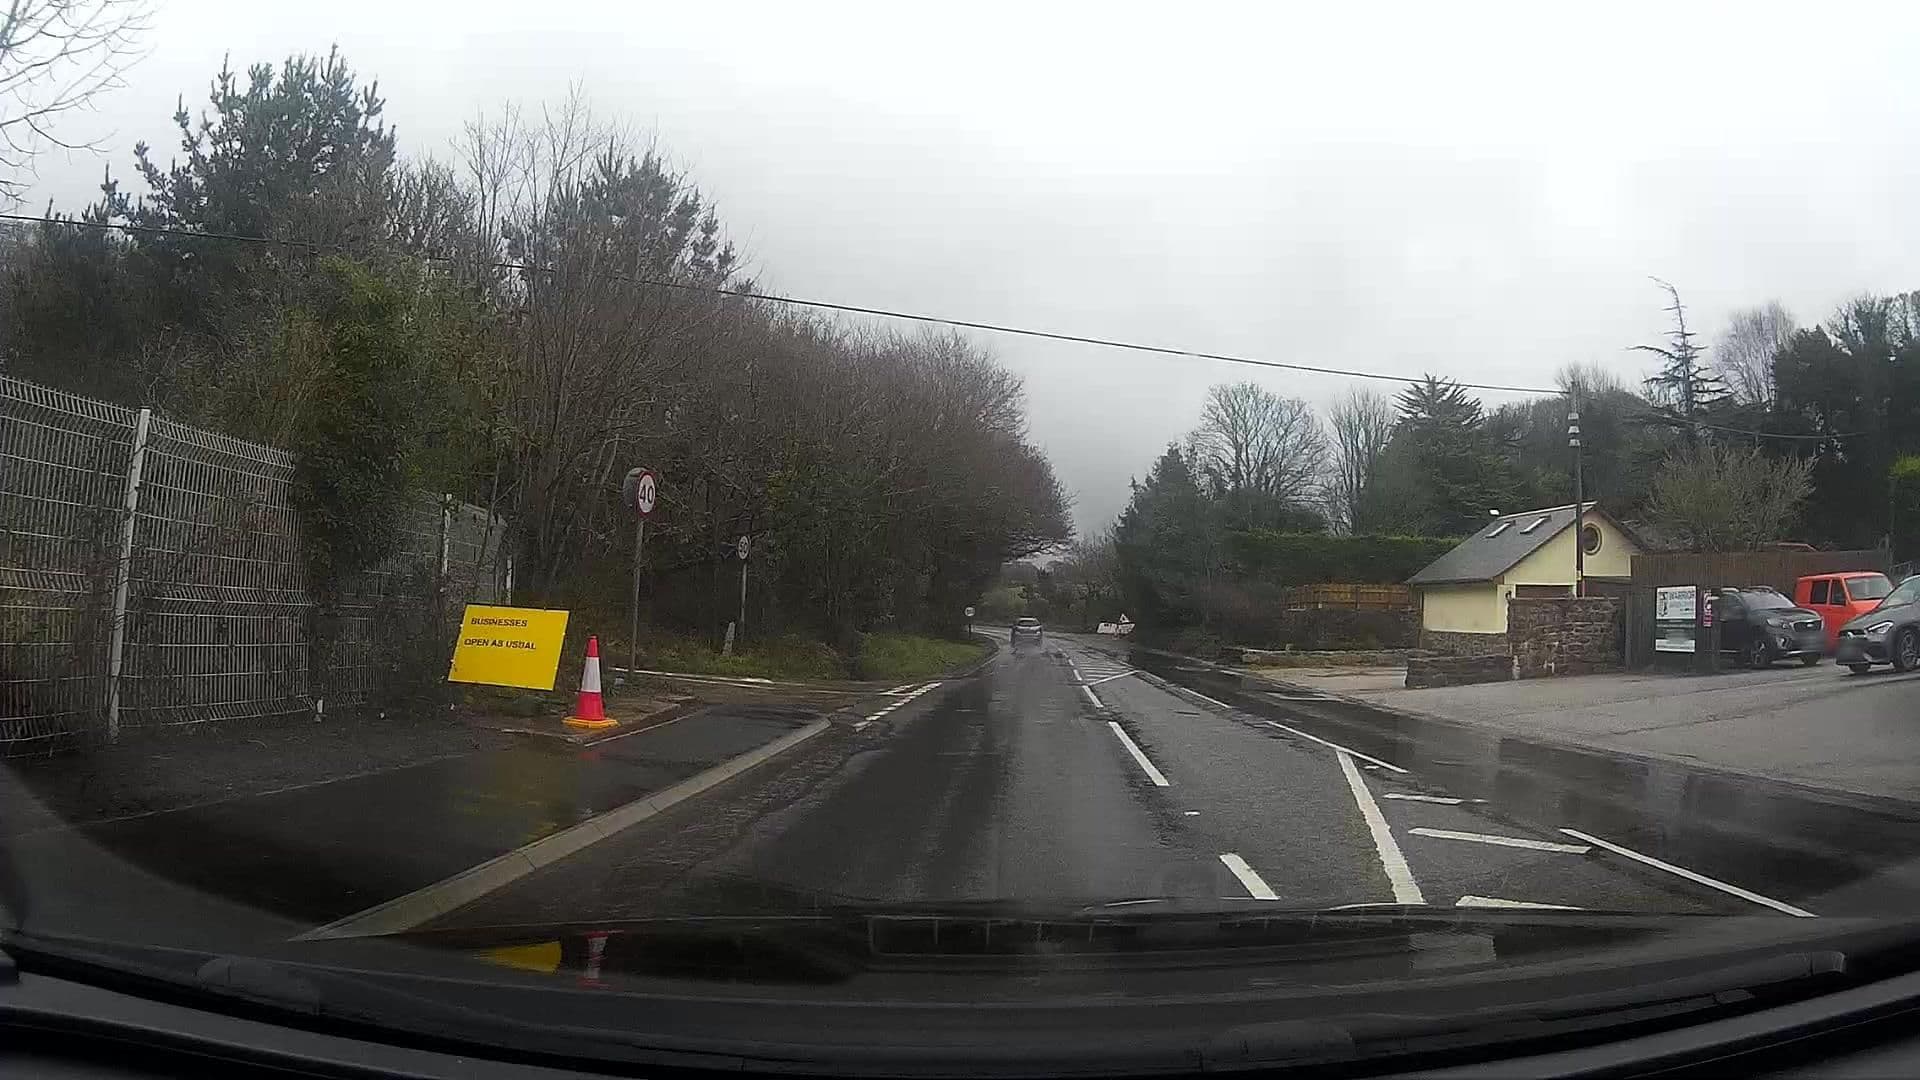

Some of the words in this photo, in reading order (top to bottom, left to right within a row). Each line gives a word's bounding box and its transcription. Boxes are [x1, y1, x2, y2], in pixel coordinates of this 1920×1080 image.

[640, 485, 654, 504] 40
[470, 617, 528, 627] BUSINESSES
[464, 638, 489, 646] OPEN
[491, 639, 503, 647] AS
[506, 640, 536, 650] USUAL
